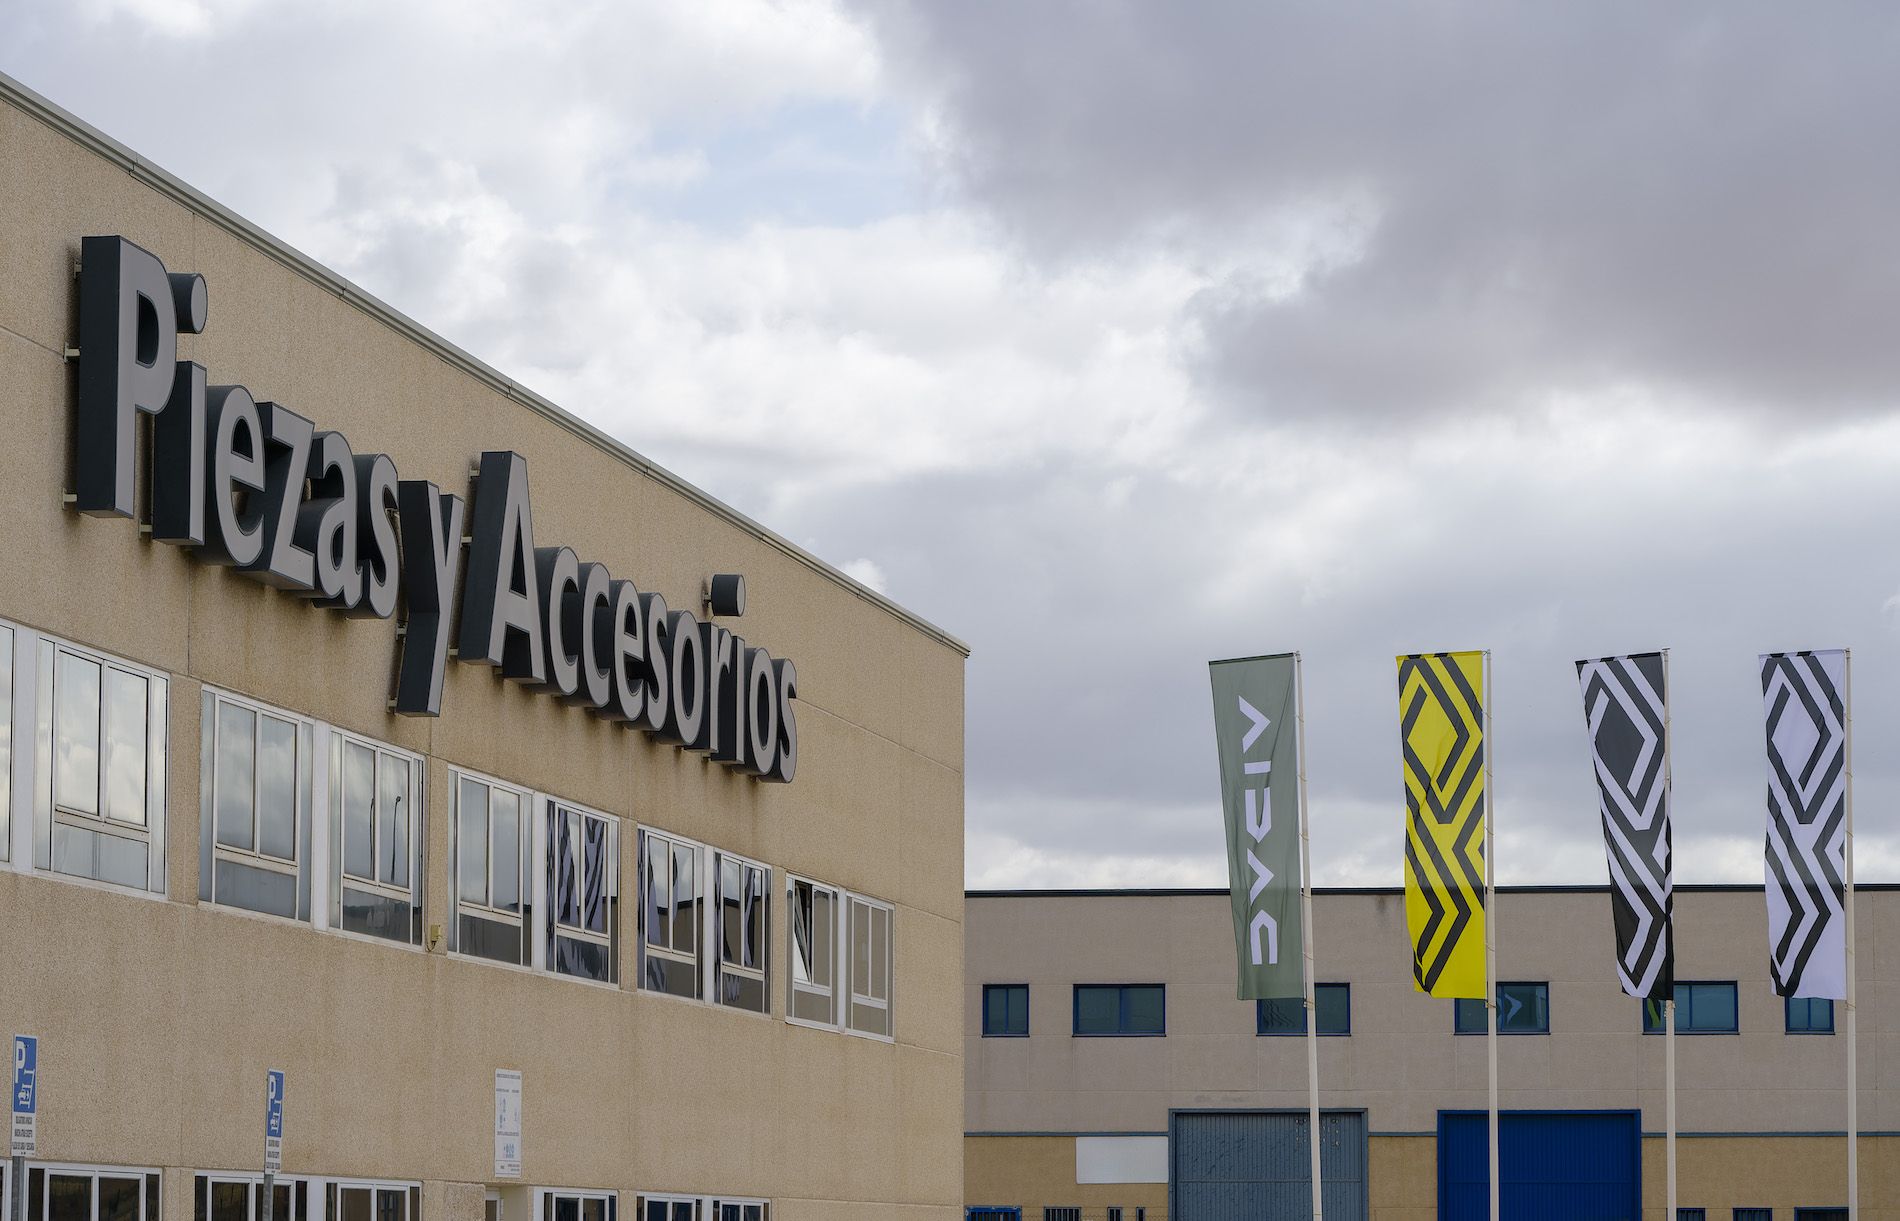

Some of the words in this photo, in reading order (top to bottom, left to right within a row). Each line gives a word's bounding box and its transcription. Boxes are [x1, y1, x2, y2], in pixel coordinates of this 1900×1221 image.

[78, 235, 399, 620] Piezas
[397, 480, 465, 717] y
[458, 450, 798, 784] Accesorios
[15, 1040, 26, 1084] P
[268, 1074, 277, 1112] P
